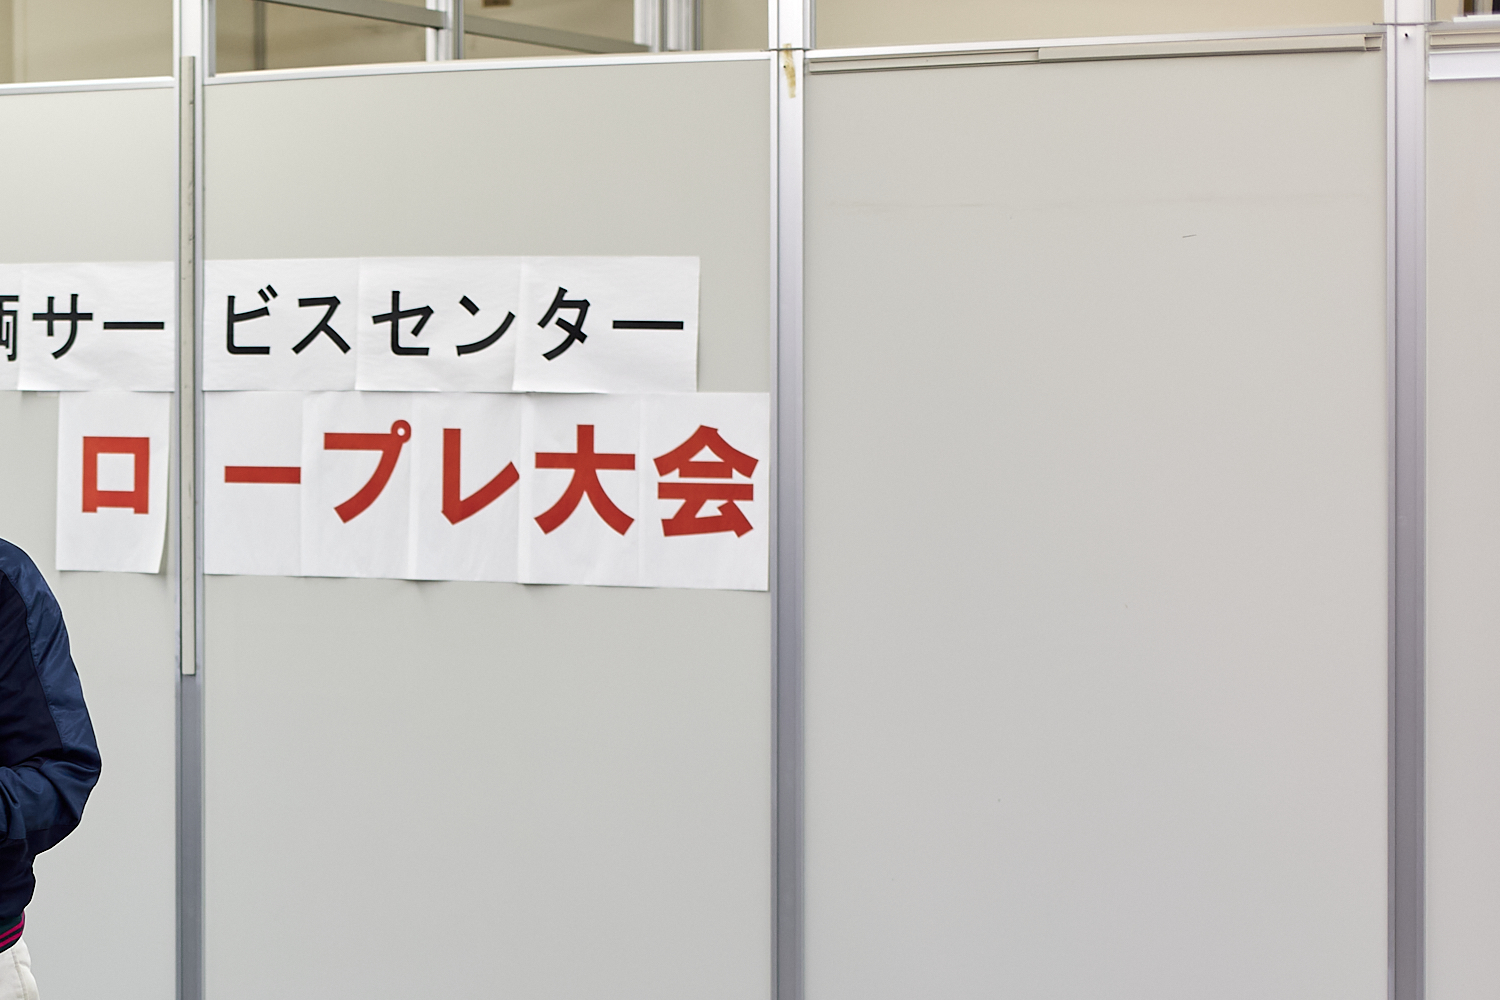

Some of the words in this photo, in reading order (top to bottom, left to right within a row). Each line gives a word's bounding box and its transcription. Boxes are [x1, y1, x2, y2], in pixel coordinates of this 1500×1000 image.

[82, 420, 759, 537] ロープレ大会
